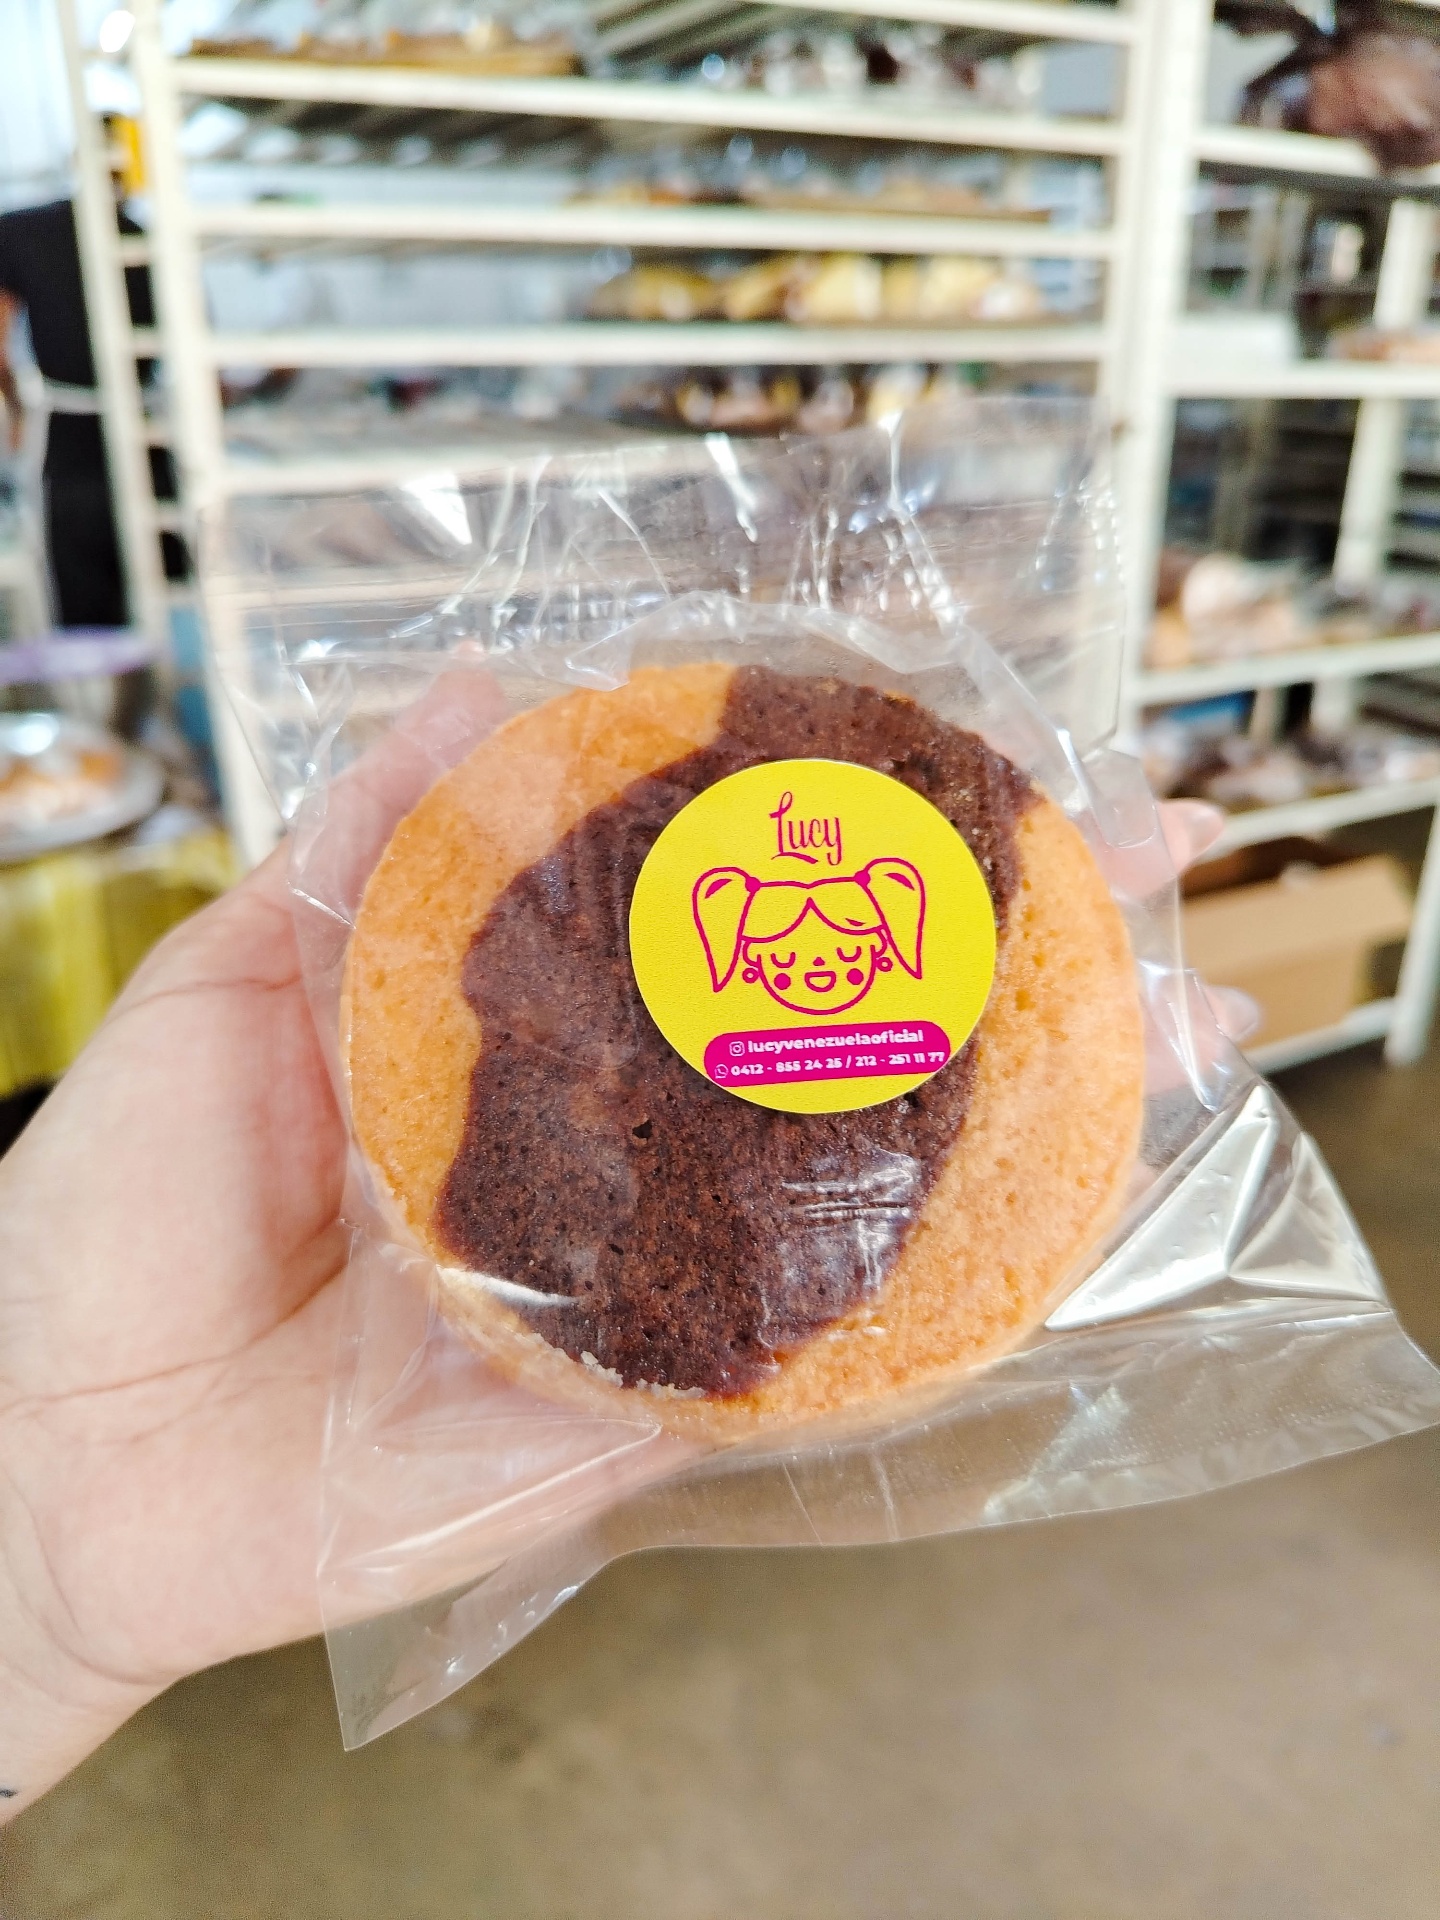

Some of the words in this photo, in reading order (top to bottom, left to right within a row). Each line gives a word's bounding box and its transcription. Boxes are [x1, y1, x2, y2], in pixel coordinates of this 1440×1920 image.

[769, 791, 842, 866] Lucy
[748, 1029, 924, 1054] lucyvenezuelaoficial
[731, 1063, 764, 1076] 0412
[804, 1059, 823, 1070] 24
[845, 1054, 852, 1069] /
[855, 1055, 877, 1067] 212
[888, 1053, 911, 1065] 251
[912, 1052, 926, 1064] 11
[927, 1051, 945, 1063] 77
